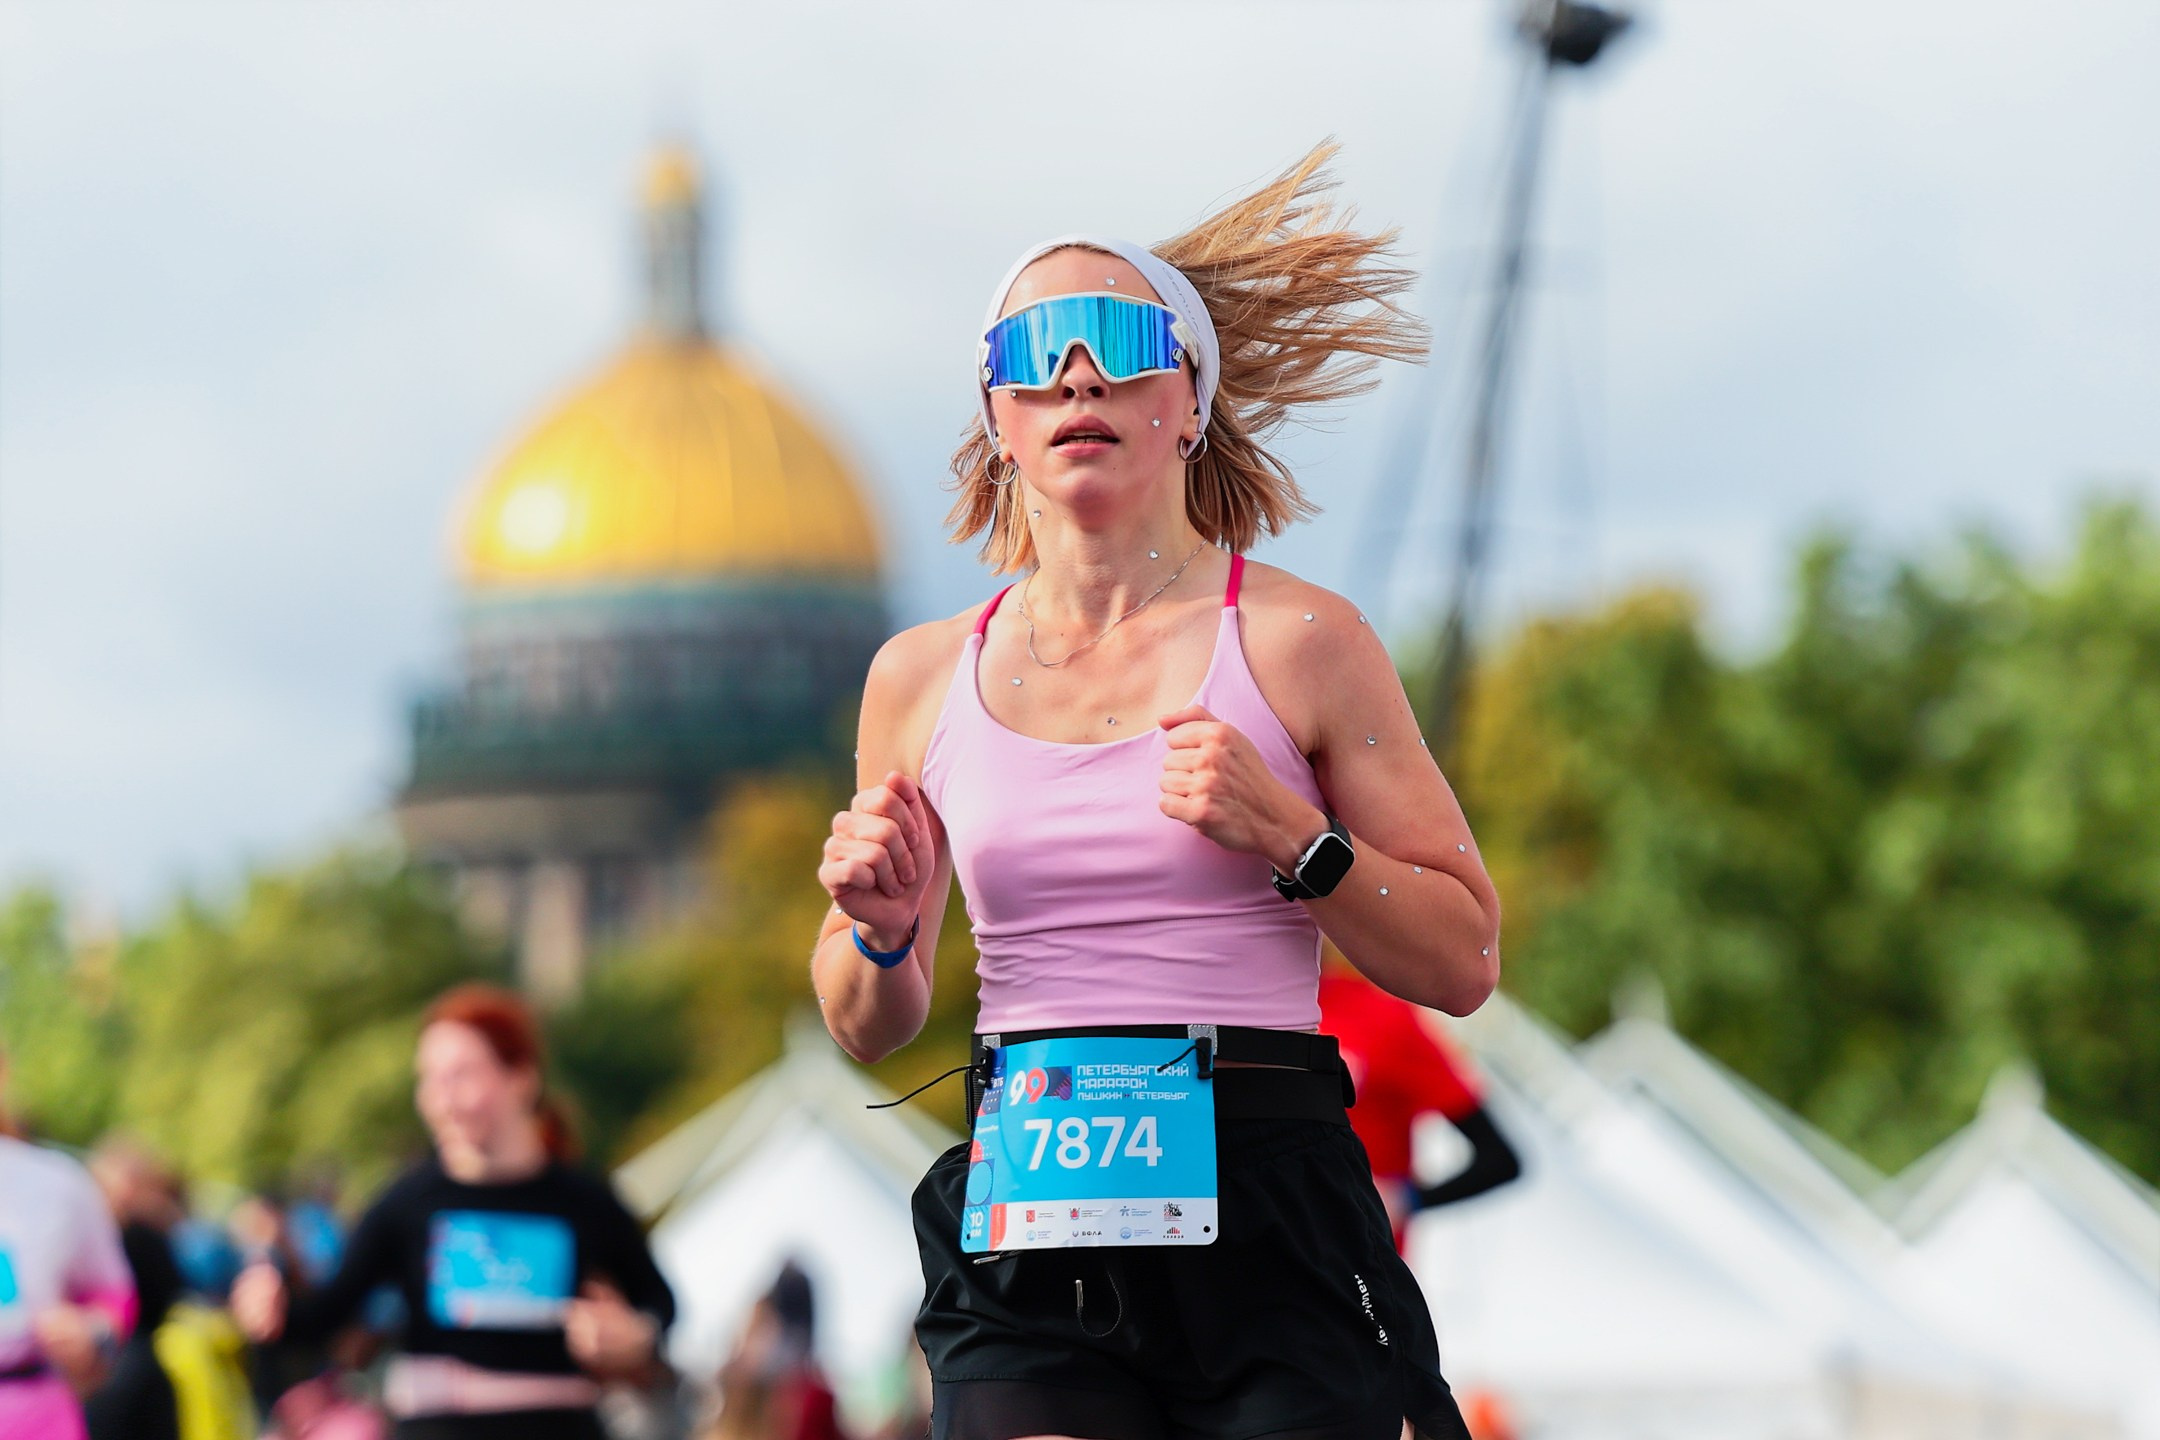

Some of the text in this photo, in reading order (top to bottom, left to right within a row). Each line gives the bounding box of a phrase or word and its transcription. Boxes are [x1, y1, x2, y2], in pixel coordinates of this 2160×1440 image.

[1077, 1063, 1190, 1077] ПЕТЕРБУРГСКИЙ
[1009, 1067, 1049, 1106] 99
[1077, 1079, 1147, 1089] МАРАФОН
[1077, 1091, 1190, 1102] ПУШКИН ПЕТЕРБУРГ
[1024, 1116, 1163, 1171] 7874
[970, 1211, 984, 1227] 10
